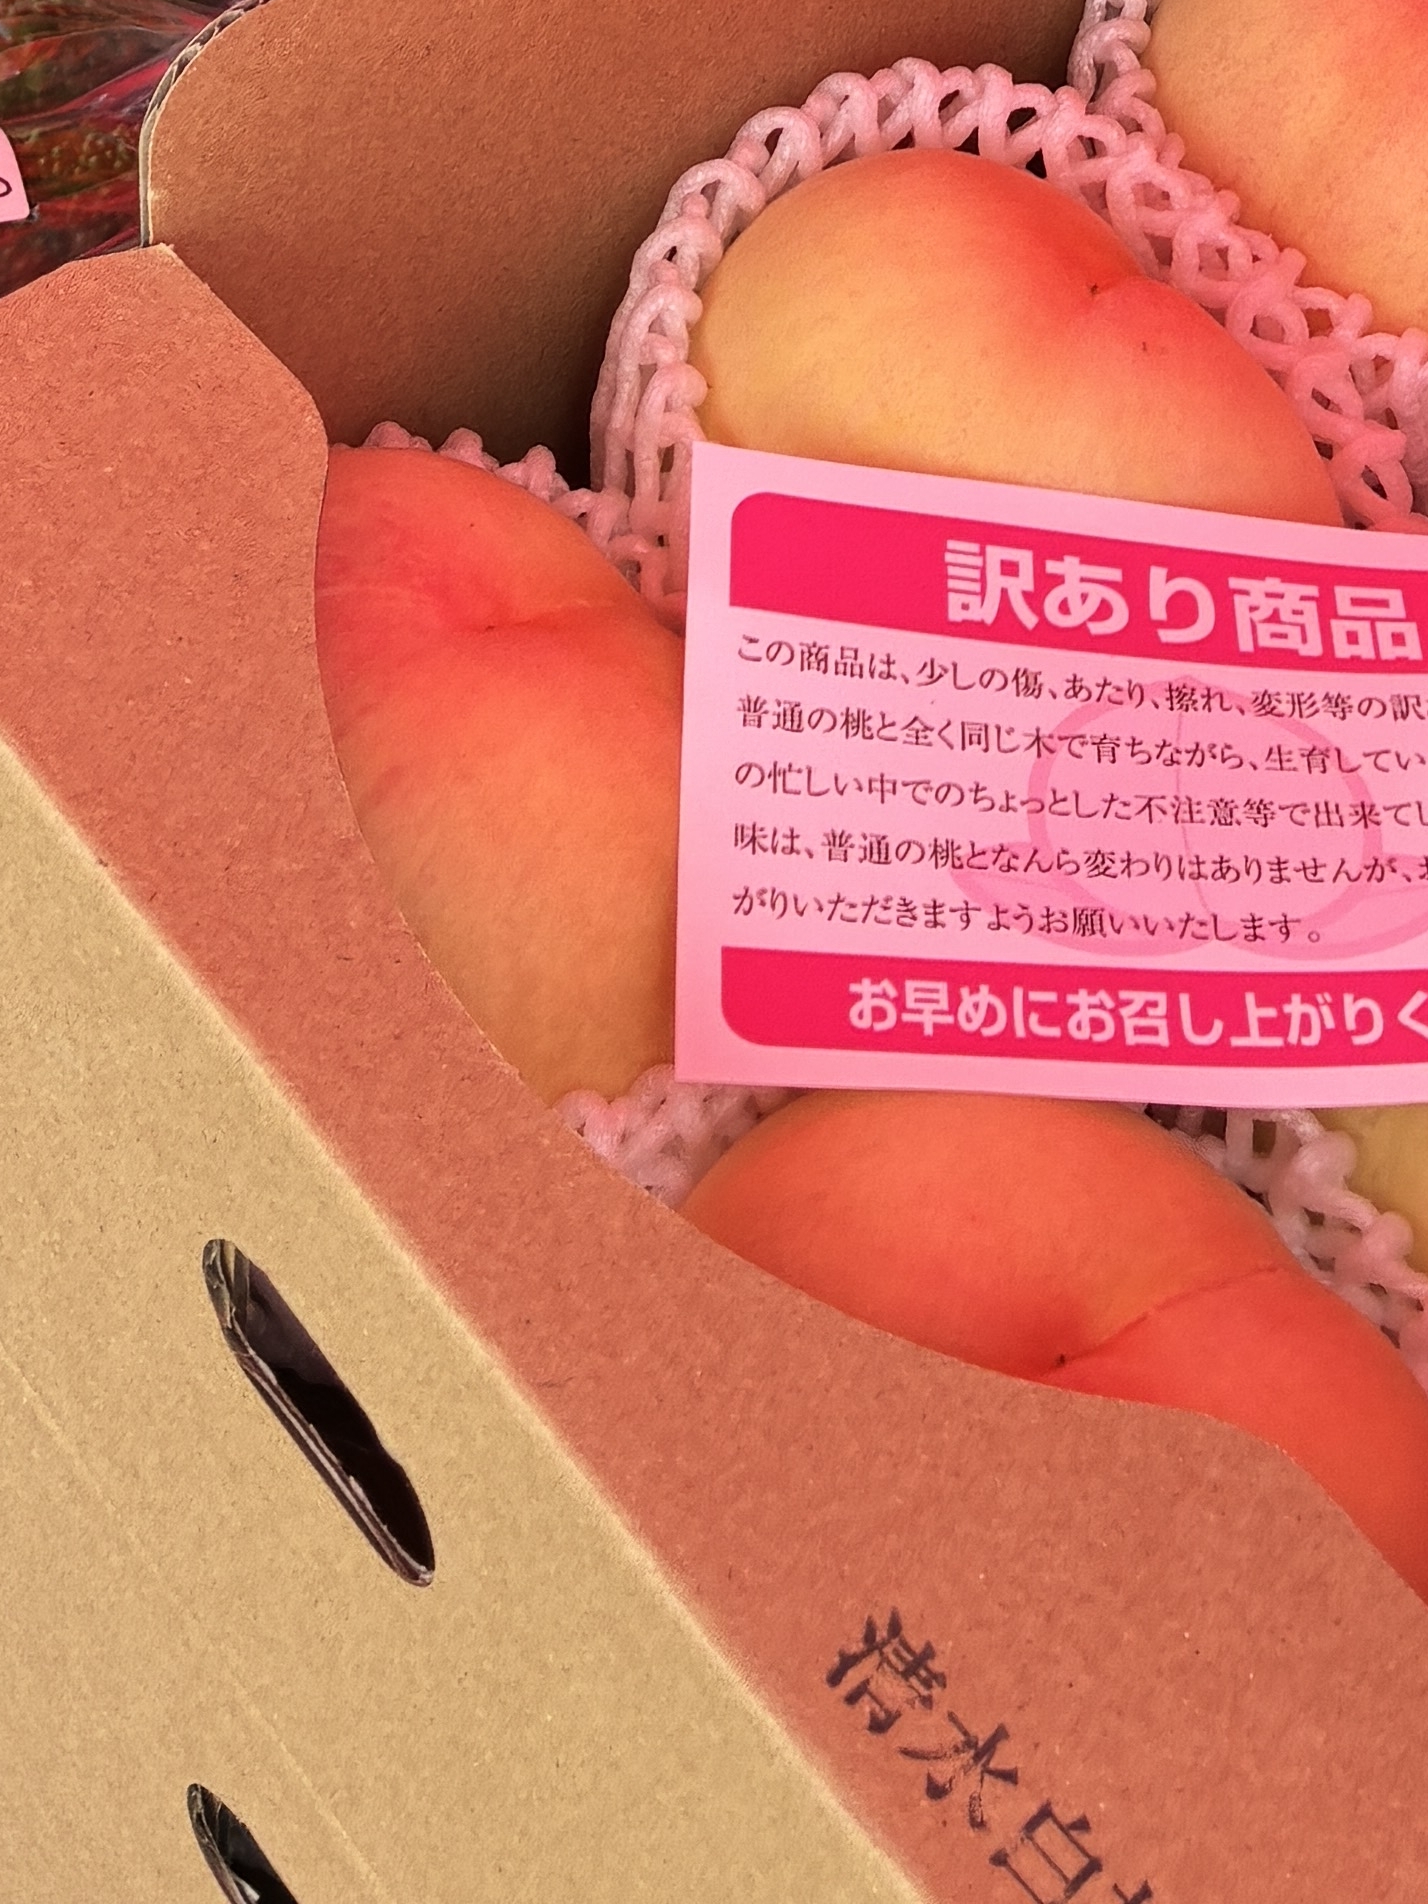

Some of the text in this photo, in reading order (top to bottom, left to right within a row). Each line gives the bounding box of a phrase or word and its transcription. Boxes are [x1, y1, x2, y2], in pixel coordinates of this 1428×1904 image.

[943, 538, 1424, 662] 訳あり商品
[732, 885, 1323, 945] がりいただきますようお願いいたします。
[825, 1605, 1155, 1904] 清水白
